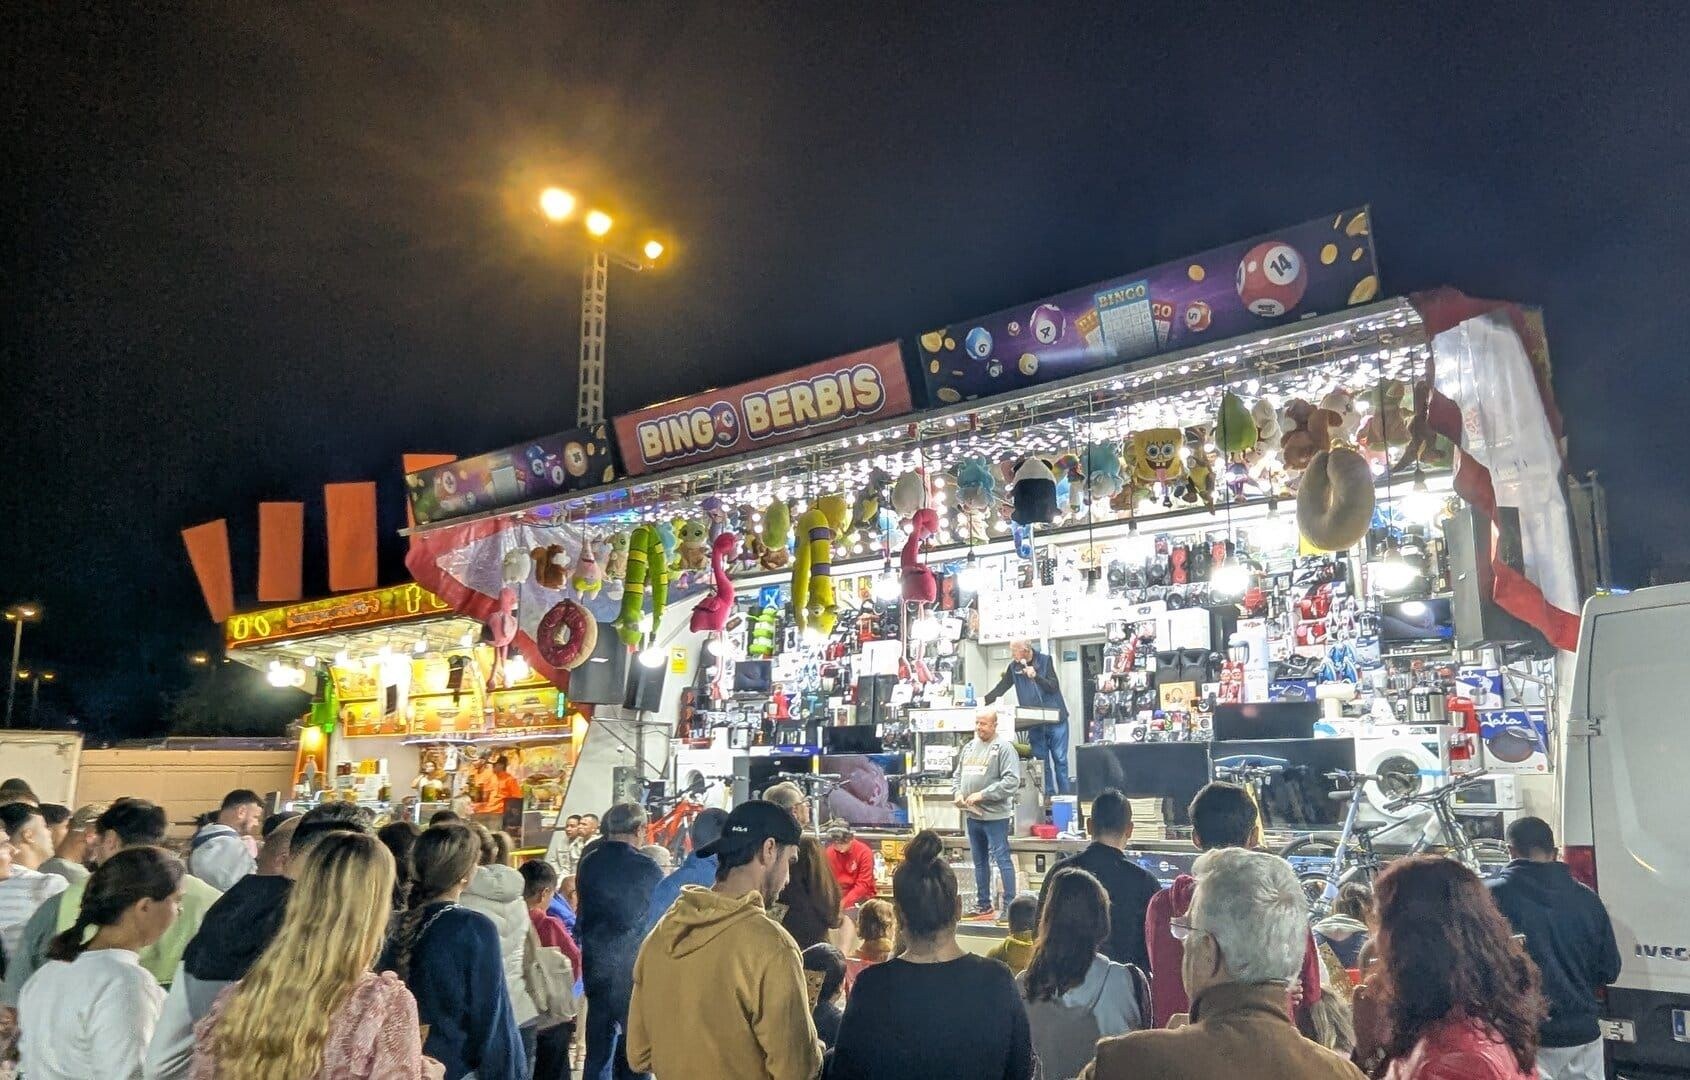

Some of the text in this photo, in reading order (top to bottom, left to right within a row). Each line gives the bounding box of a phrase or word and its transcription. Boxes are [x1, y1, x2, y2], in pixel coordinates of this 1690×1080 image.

[1269, 253, 1293, 277] 14
[1098, 285, 1147, 308] BINGO
[743, 367, 881, 433] BERBIS
[1480, 711, 1522, 726] Jata
[1635, 944, 1690, 960] IVEC
